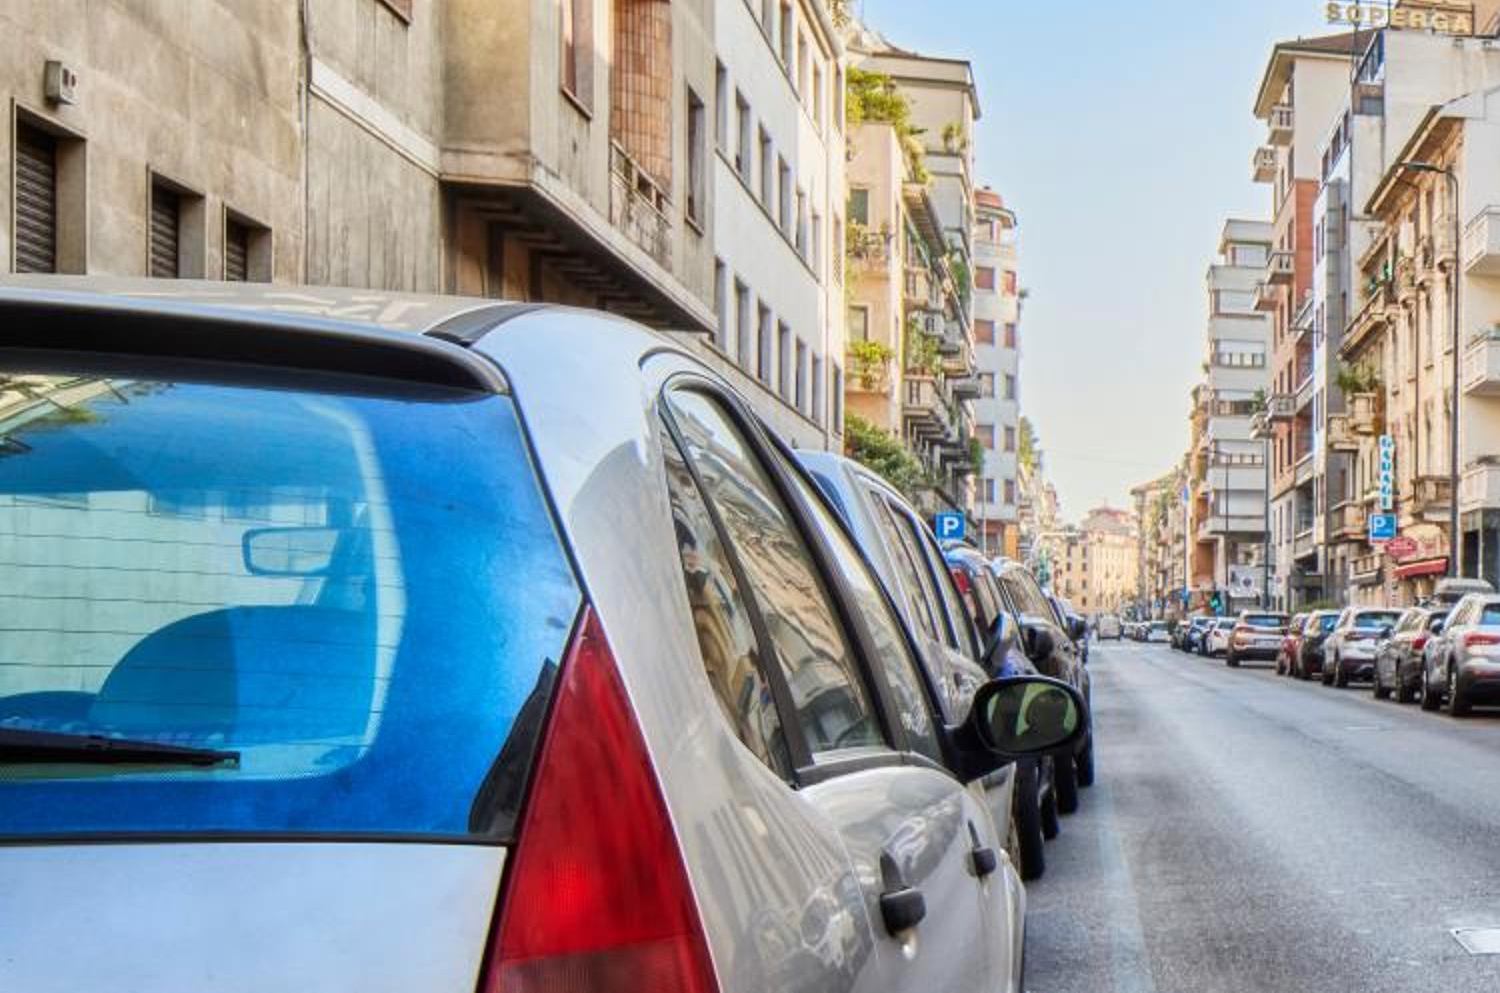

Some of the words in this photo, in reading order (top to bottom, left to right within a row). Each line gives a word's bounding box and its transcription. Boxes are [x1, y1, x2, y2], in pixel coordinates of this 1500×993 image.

[1326, 1, 1472, 34] SOPERGA
[943, 516, 959, 536] P
[1373, 515, 1387, 534] P
